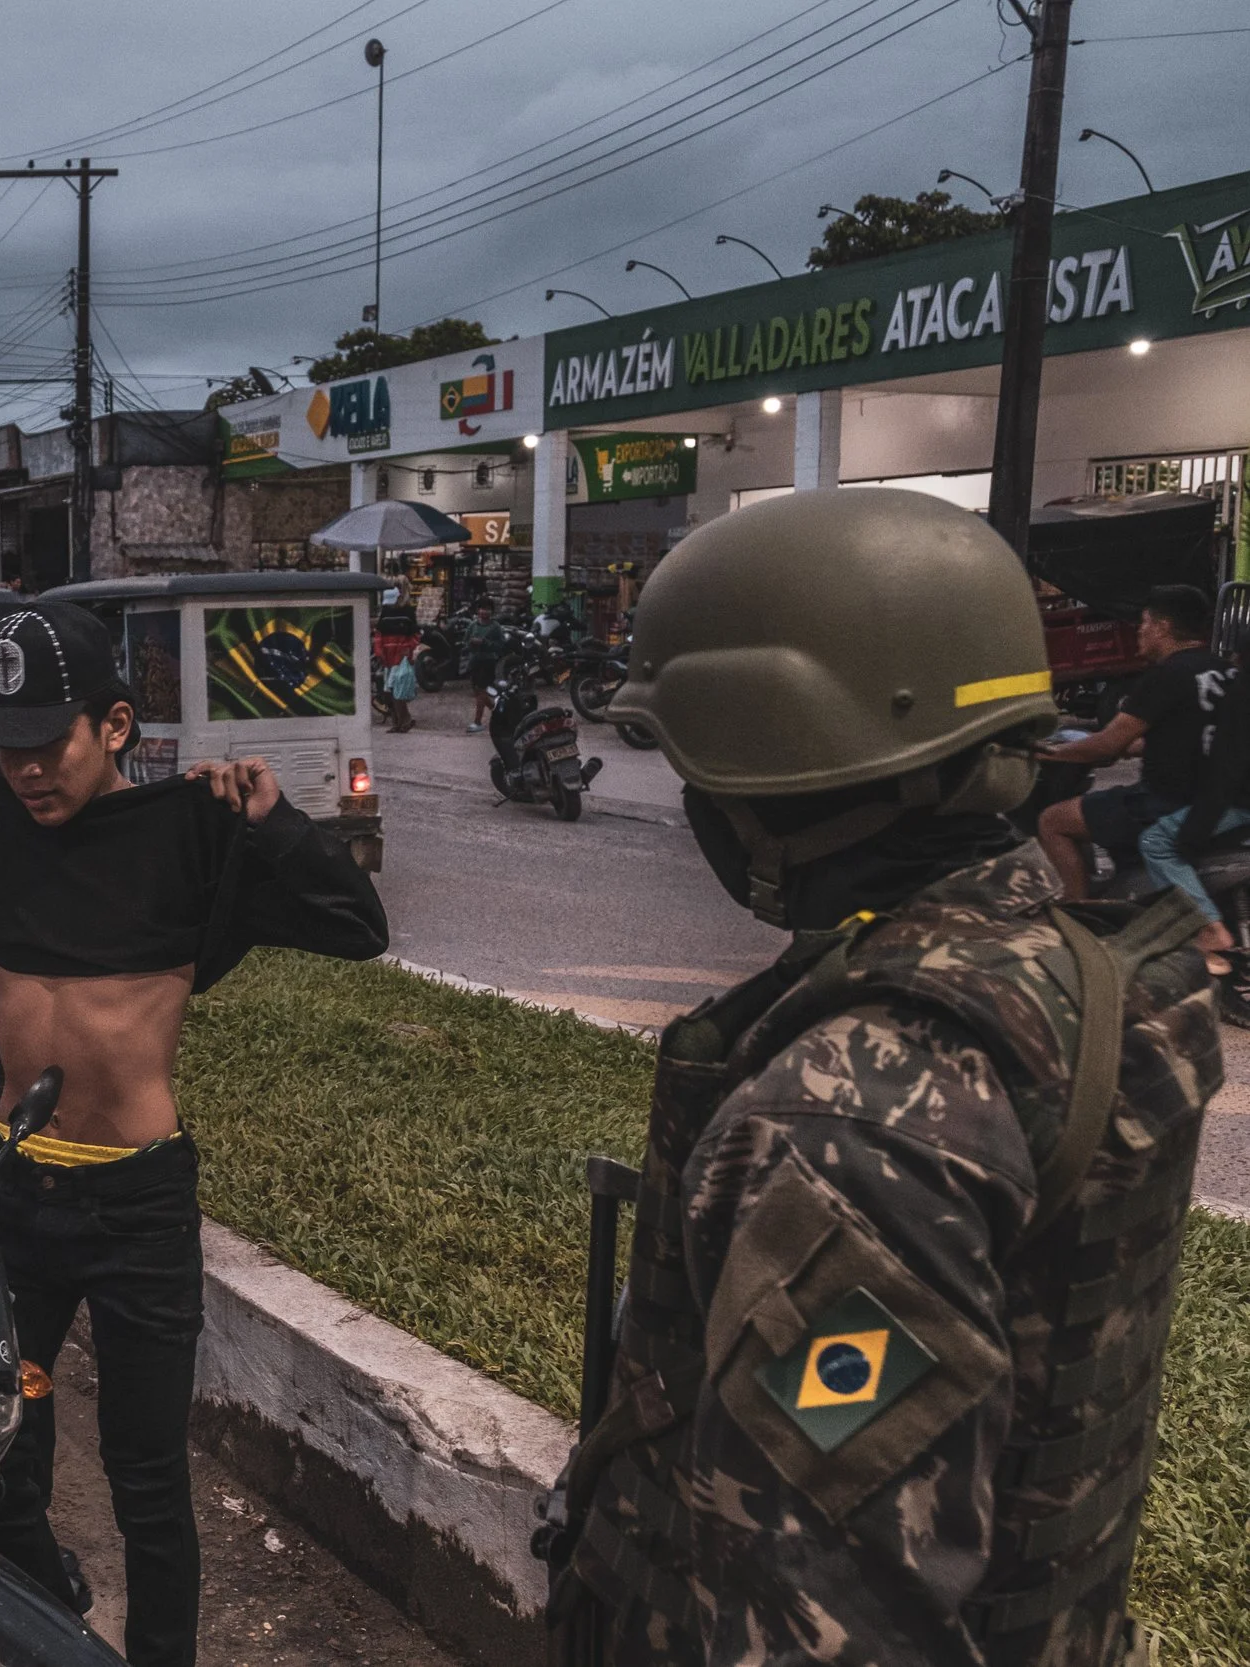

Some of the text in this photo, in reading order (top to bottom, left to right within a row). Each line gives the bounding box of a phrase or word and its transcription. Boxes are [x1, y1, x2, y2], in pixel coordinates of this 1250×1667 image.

[1205, 225, 1250, 282] AV
[549, 245, 1134, 407] ARMAZÉM VALLADARES ATACAISTA
[330, 376, 390, 438] KEILA
